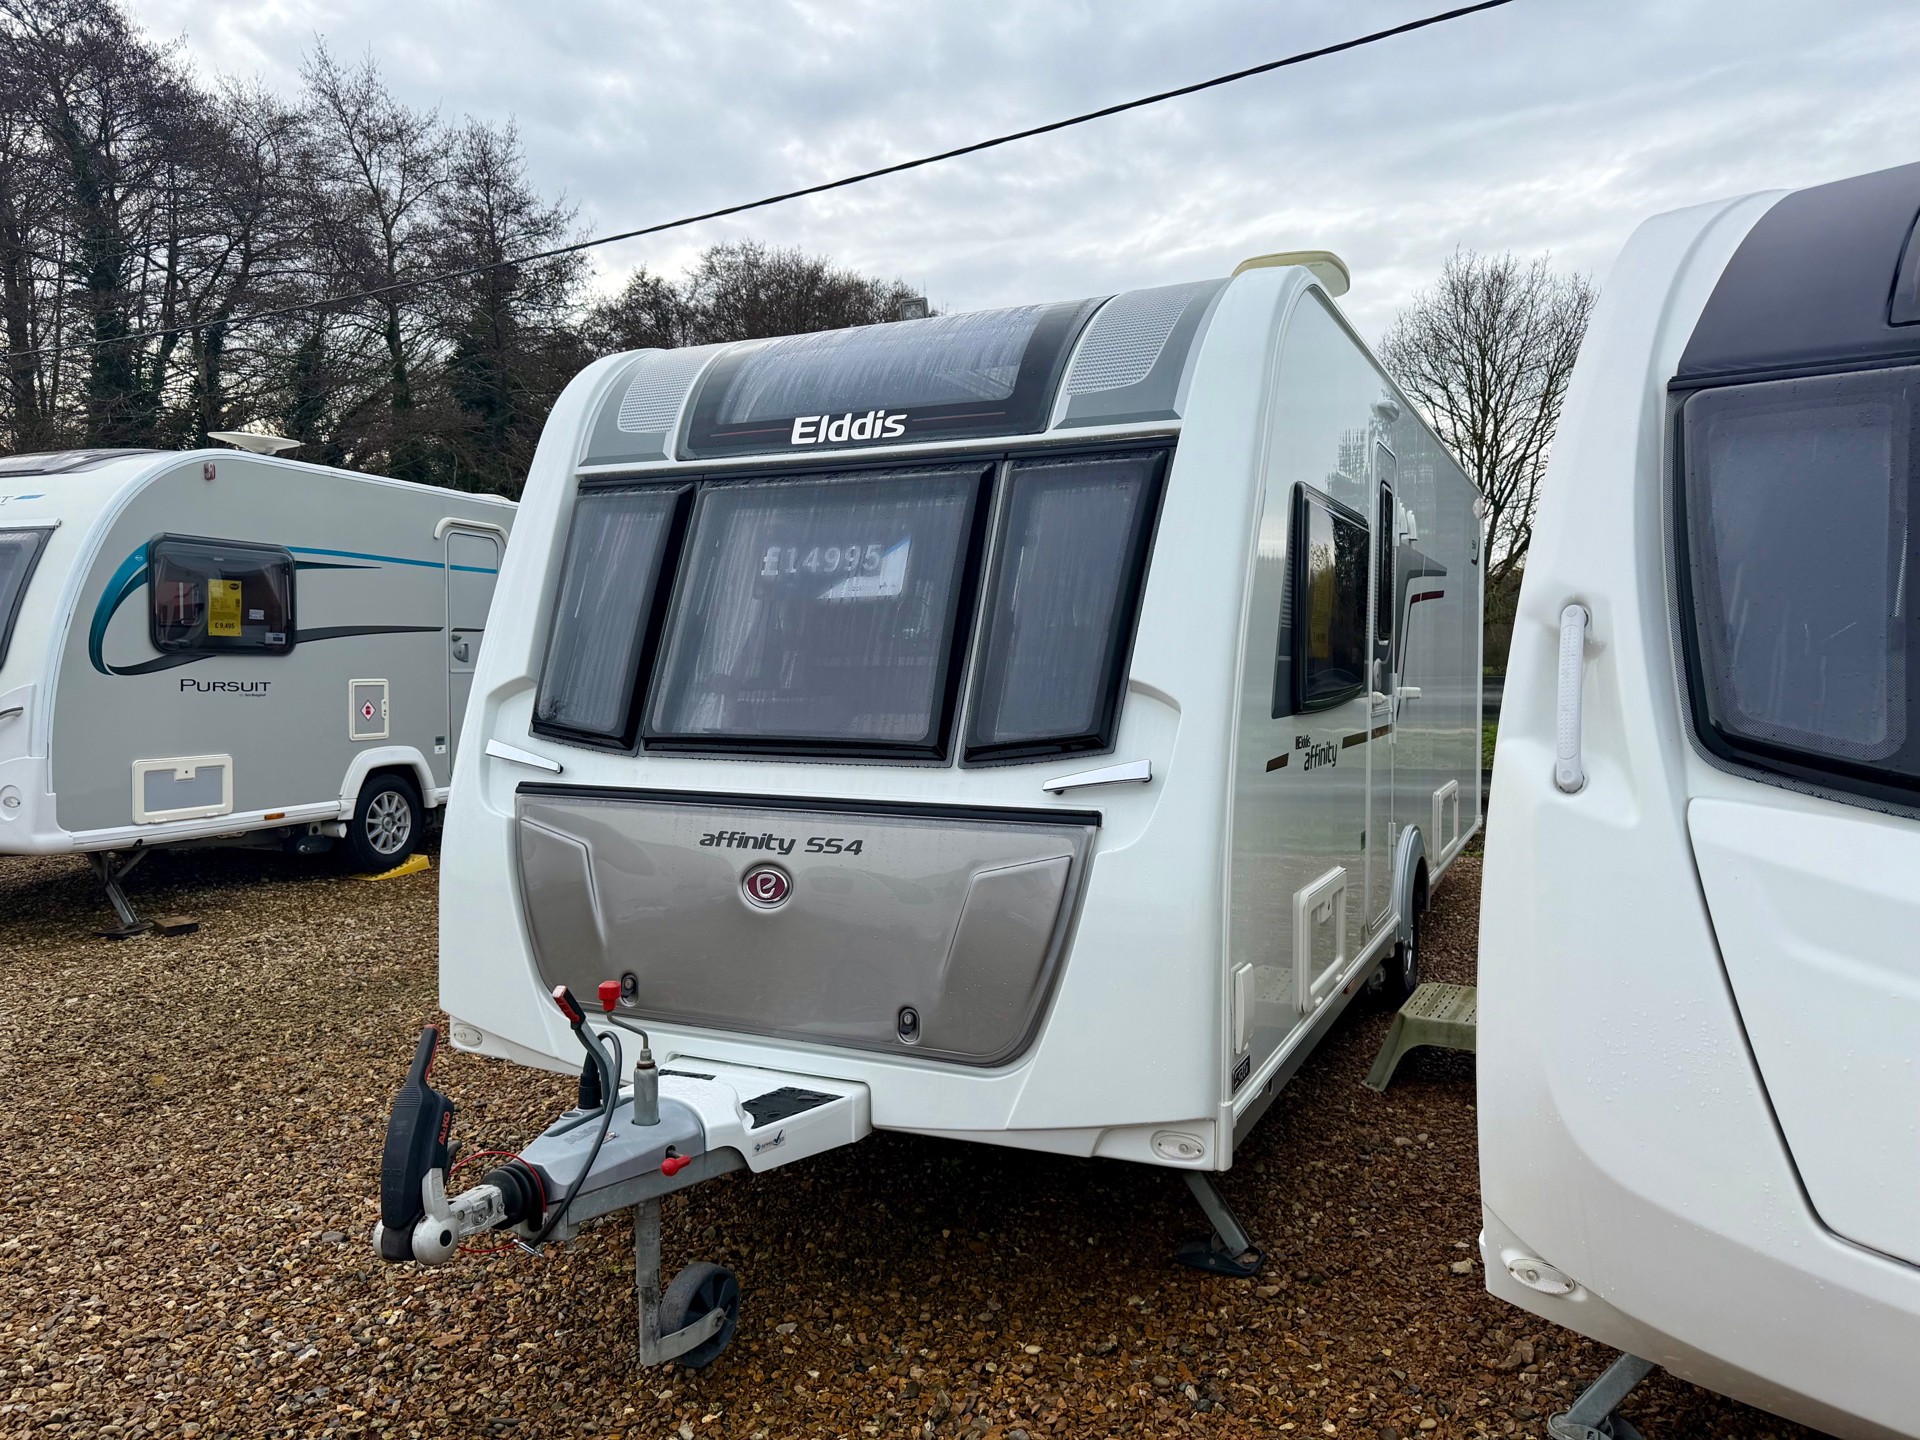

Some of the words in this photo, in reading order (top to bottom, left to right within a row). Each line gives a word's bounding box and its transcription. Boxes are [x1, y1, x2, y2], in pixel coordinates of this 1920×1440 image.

[791, 410, 907, 445] Elddis
[761, 543, 883, 576] £14995
[1304, 740, 1338, 771] affinity
[699, 830, 796, 855] affinity
[438, 1111, 451, 1146] AL-KO
